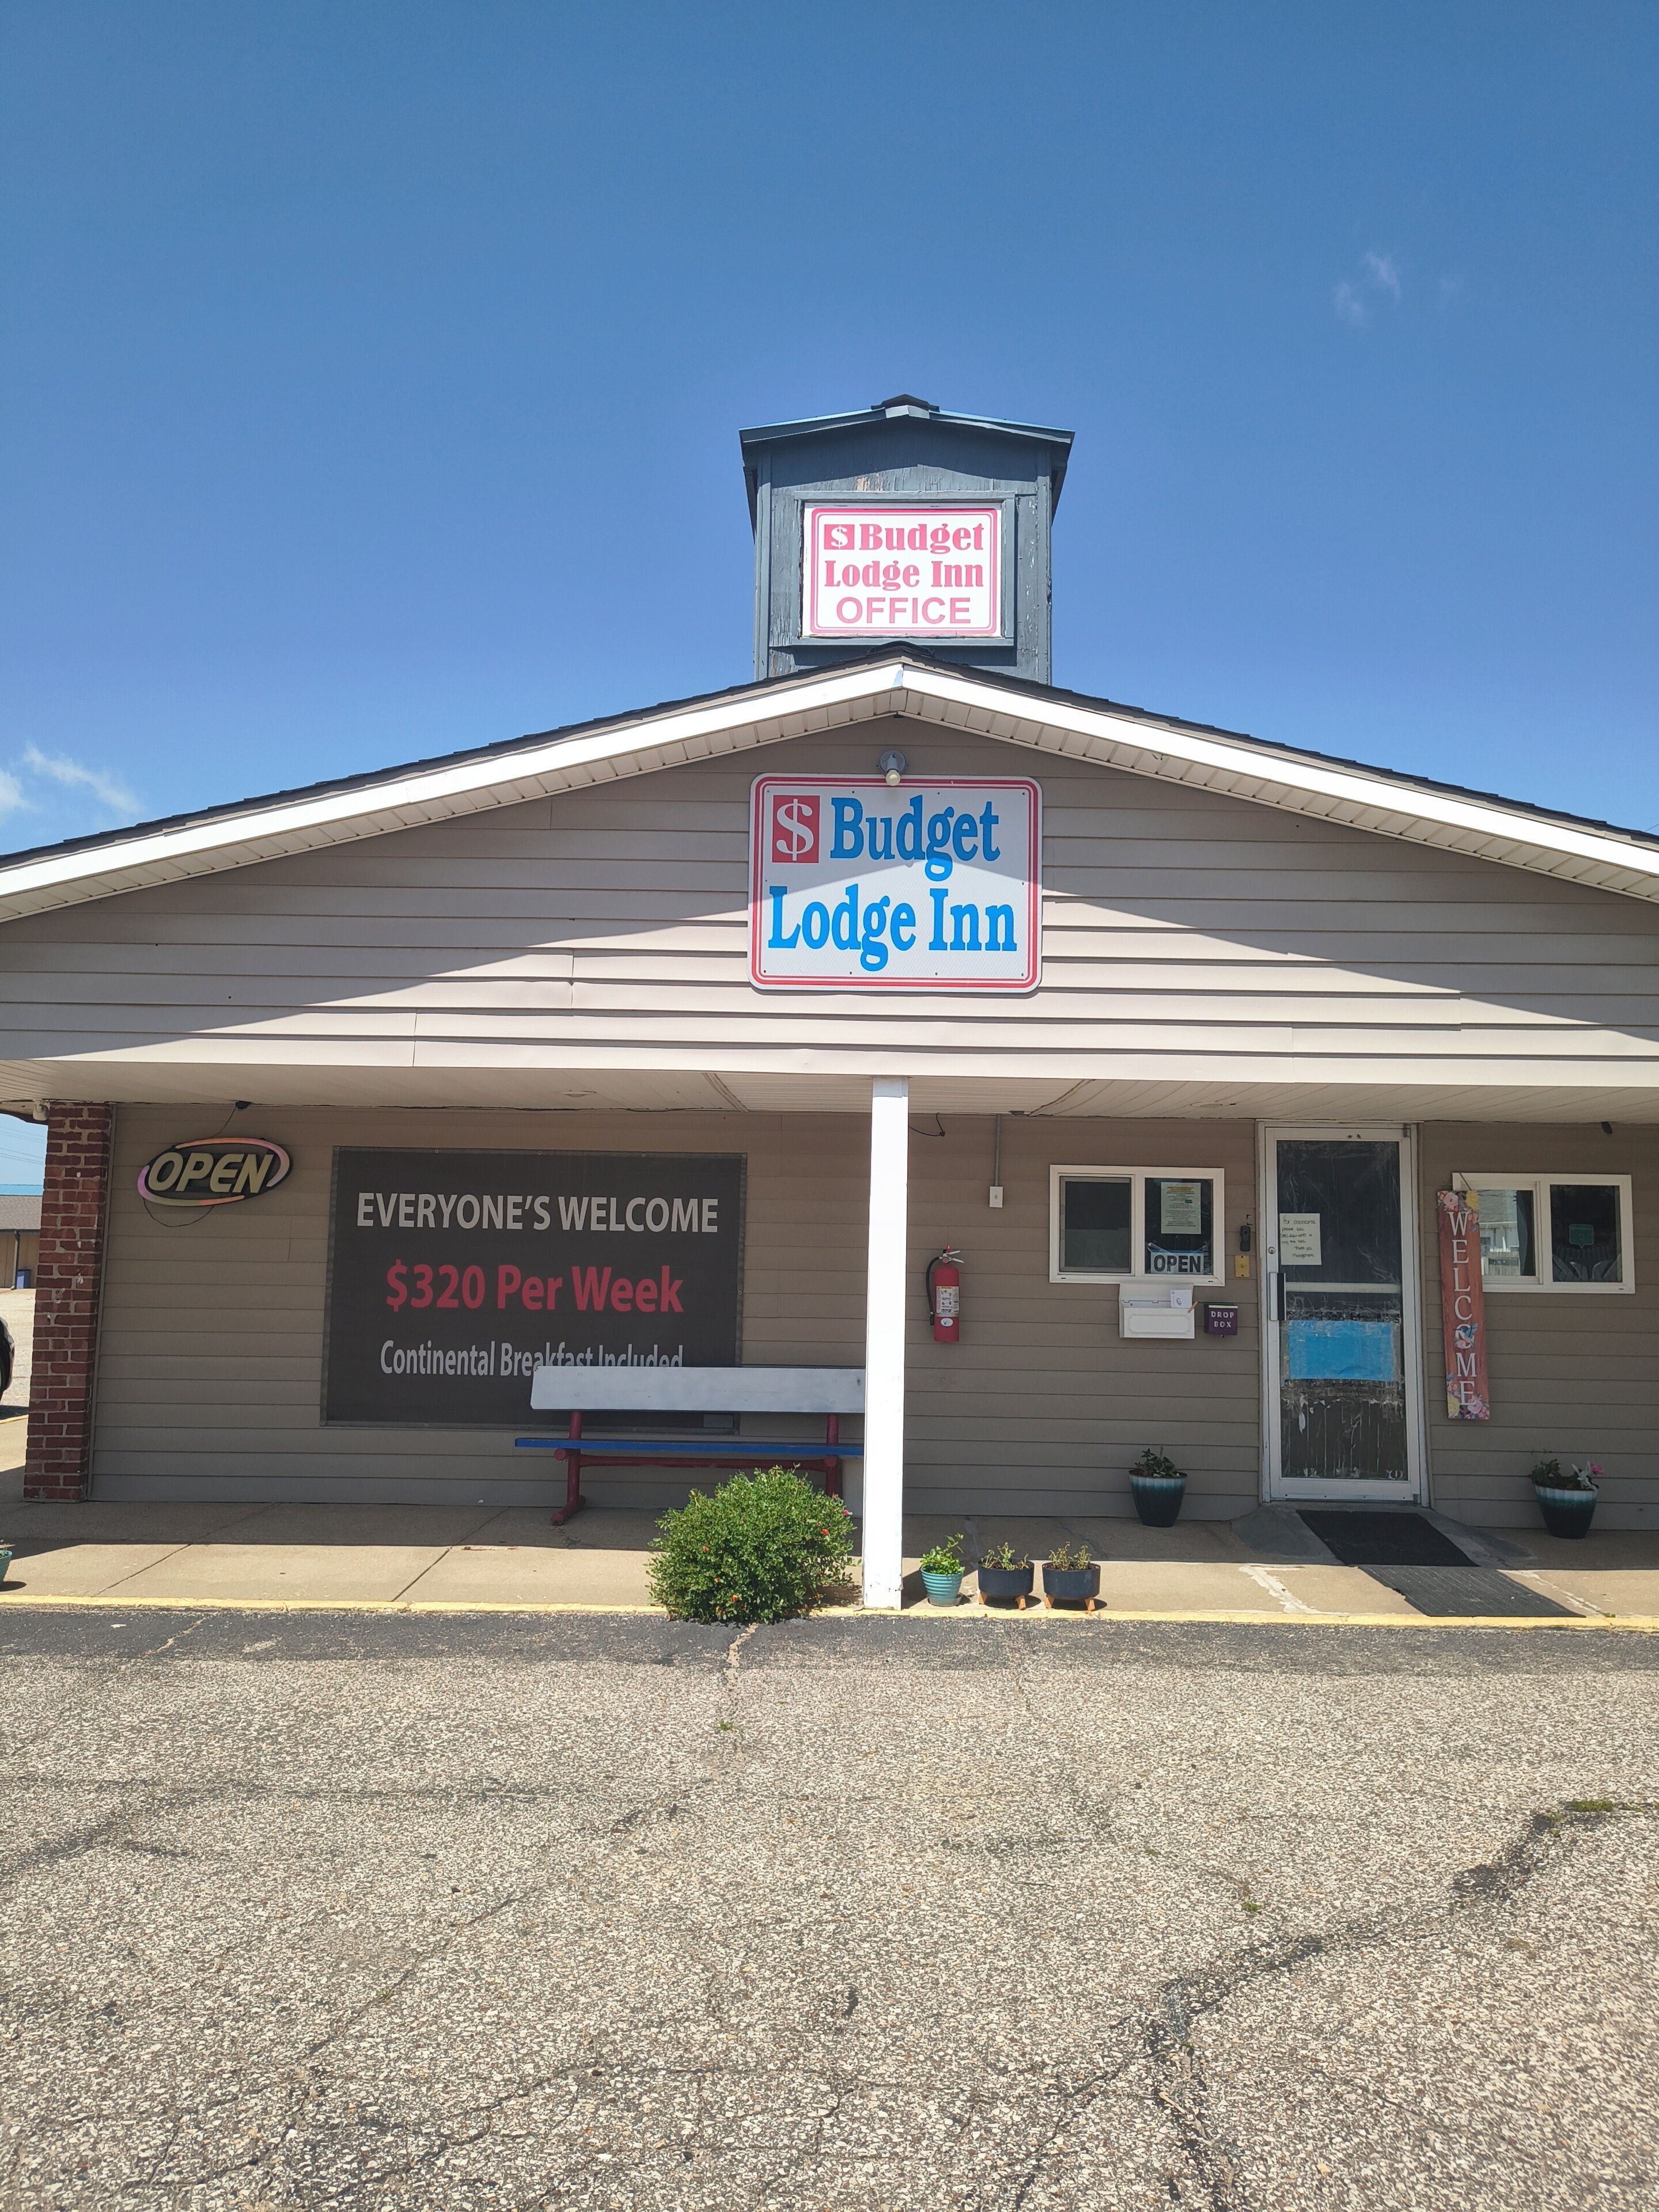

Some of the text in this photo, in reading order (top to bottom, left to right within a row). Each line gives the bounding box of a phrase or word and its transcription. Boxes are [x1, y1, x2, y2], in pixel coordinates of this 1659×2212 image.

[859, 523, 984, 555] Budget
[824, 560, 984, 591] Lodge Inn
[836, 596, 971, 624] OFFICE
[830, 794, 1001, 882] Budget
[768, 883, 1017, 972] Lodge Inn
[147, 1152, 275, 1194] OPEN
[357, 1192, 718, 1233] EVERYONE'S WELCOME
[1153, 1255, 1202, 1273] OPEN
[385, 1259, 684, 1313] $320 Per Week
[1211, 1310, 1235, 1319] DROP
[380, 1340, 495, 1376] Continental
